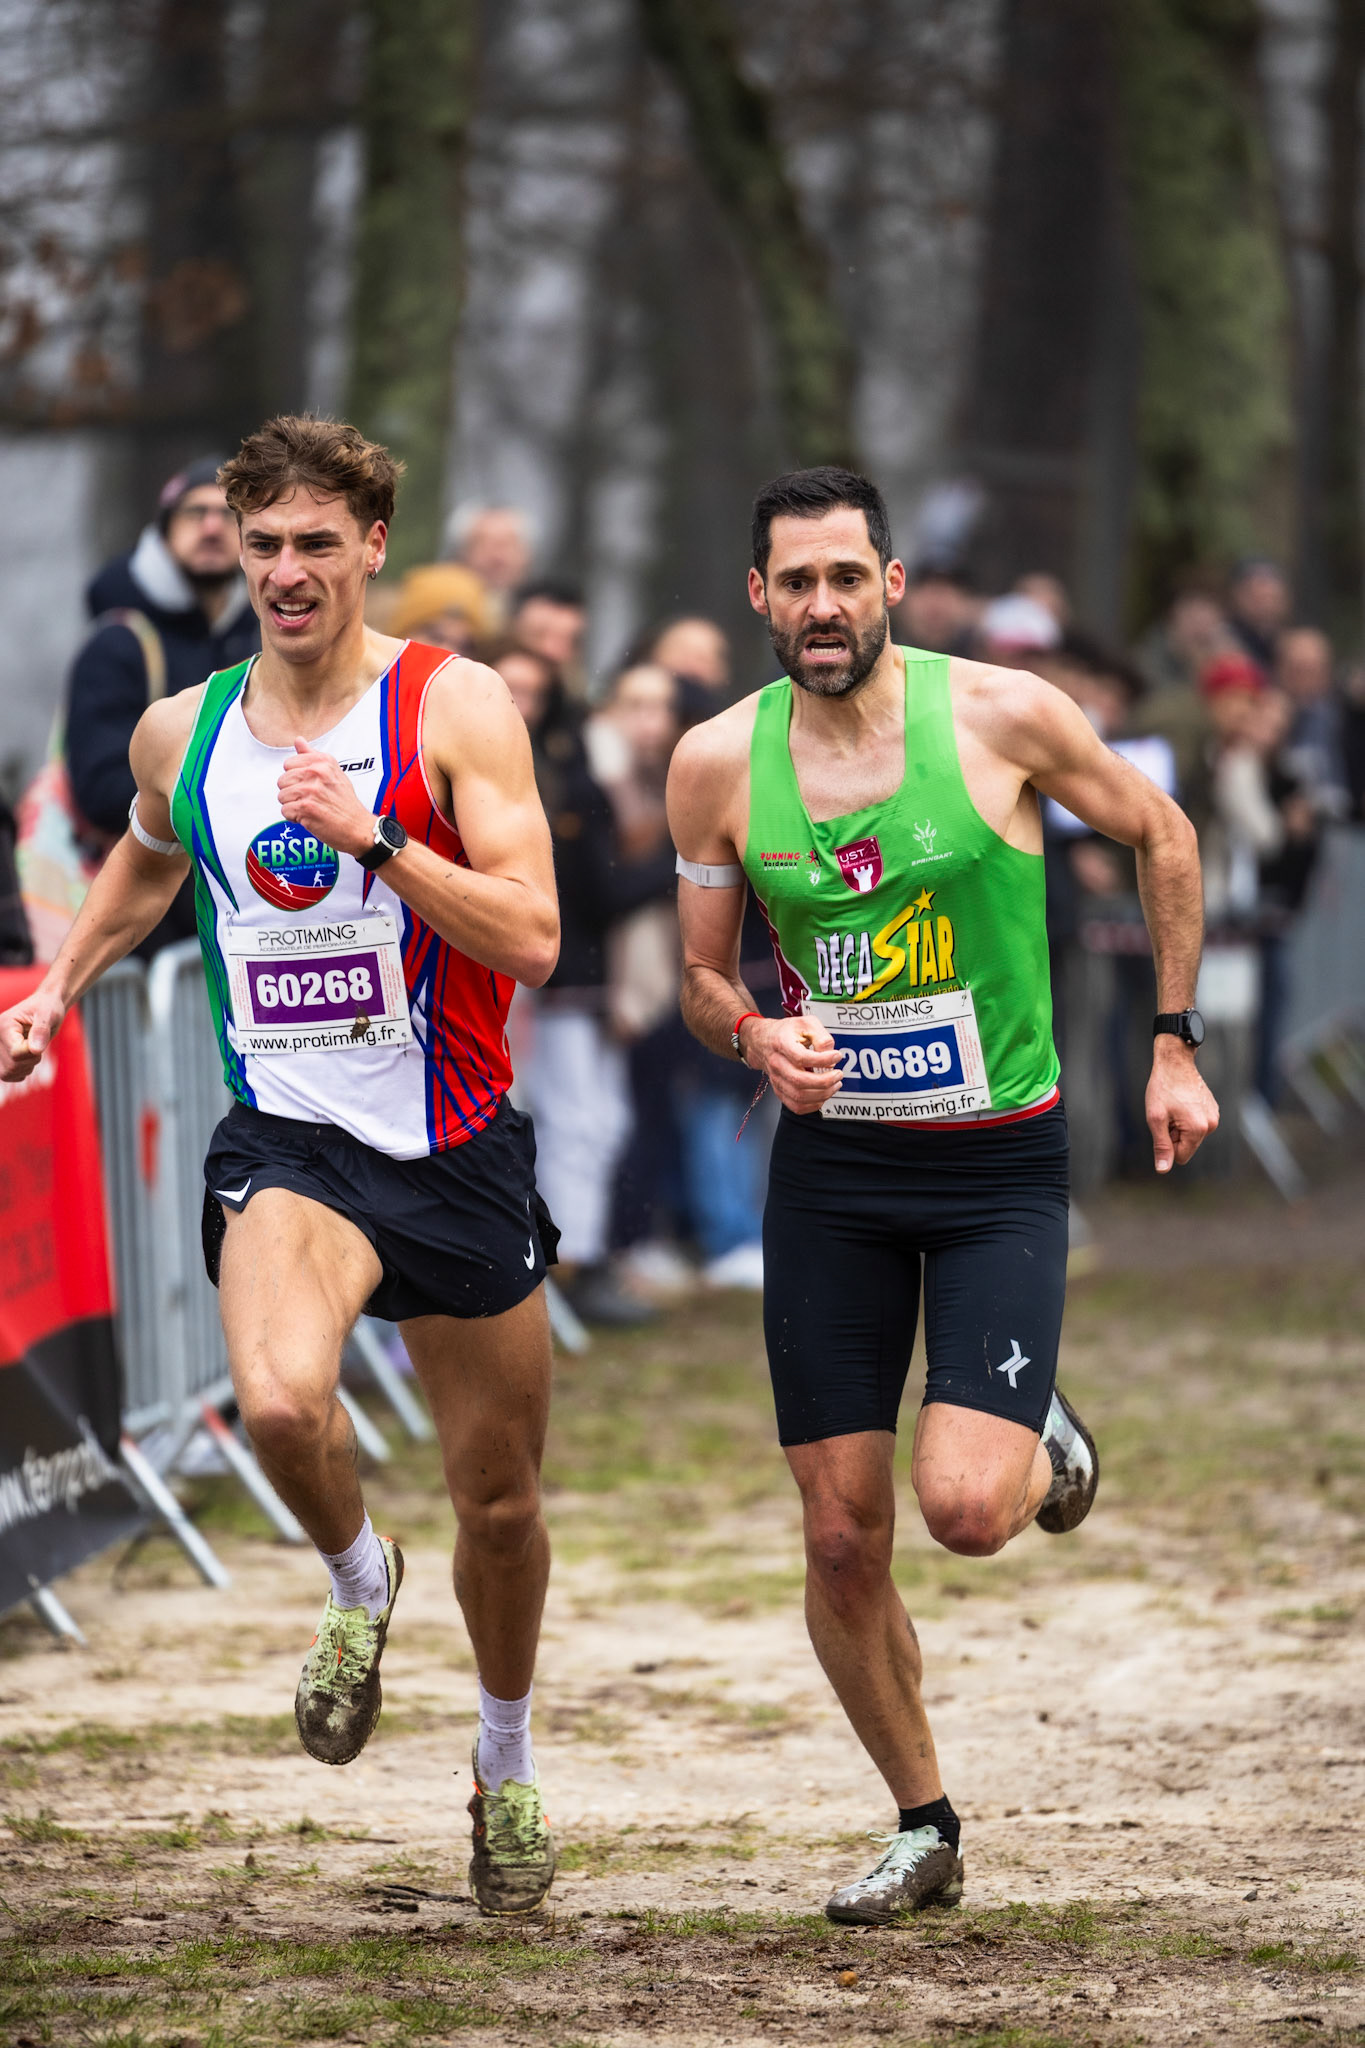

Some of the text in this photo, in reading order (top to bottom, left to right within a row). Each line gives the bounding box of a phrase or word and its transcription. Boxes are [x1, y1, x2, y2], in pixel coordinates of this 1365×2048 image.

[257, 837, 336, 868] EBSBA
[760, 852, 800, 861] RUNNING
[257, 924, 357, 946] PROTIMING
[256, 967, 373, 1008] 60268
[836, 1000, 934, 1021] PROTIMING
[837, 1041, 952, 1080] 20689
[834, 1094, 975, 1119] www.protiming.fr
